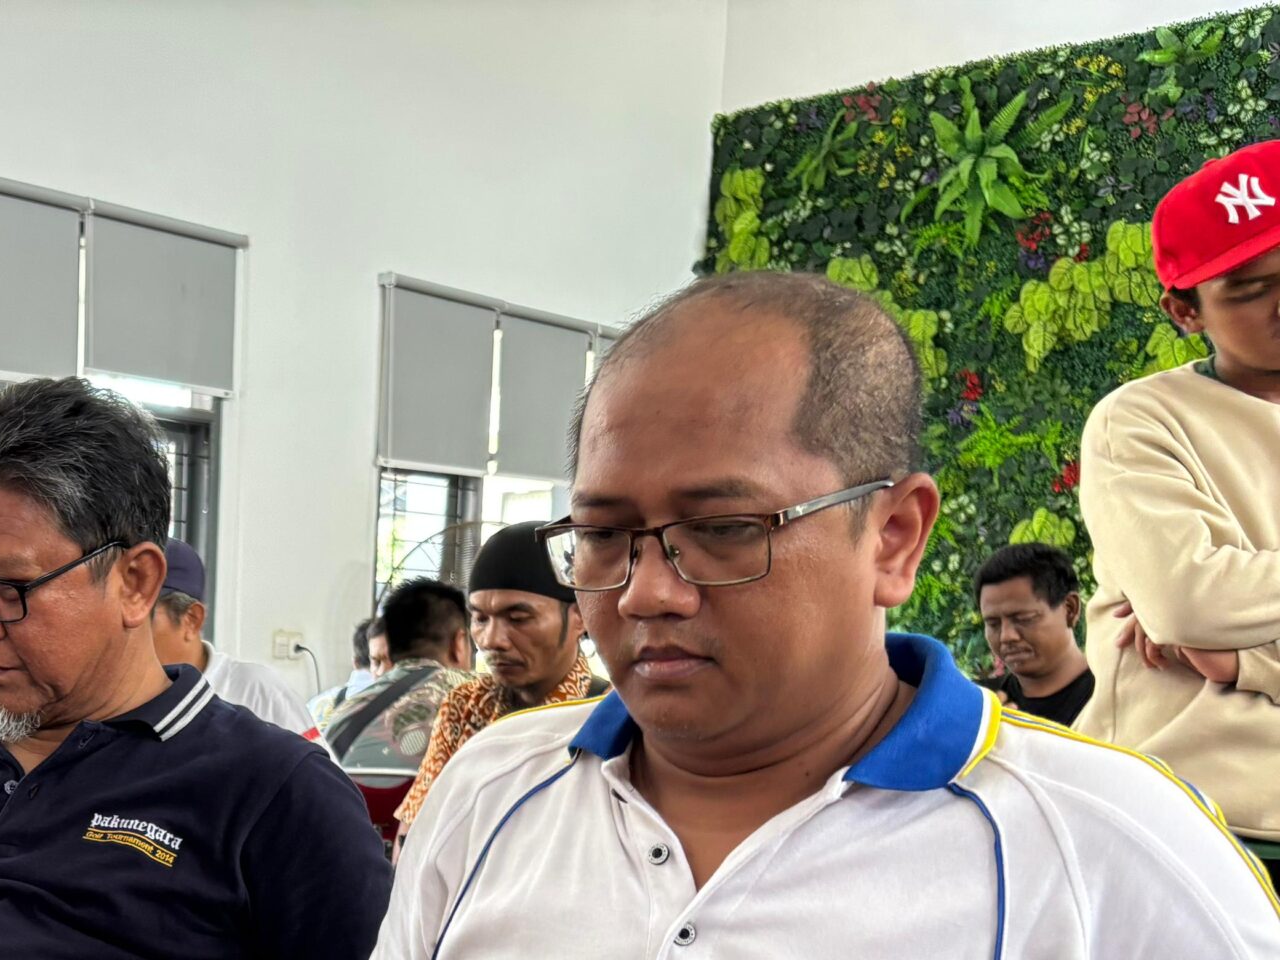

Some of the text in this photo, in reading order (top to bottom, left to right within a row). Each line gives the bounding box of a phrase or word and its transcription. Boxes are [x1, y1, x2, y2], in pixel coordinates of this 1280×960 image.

[1214, 173, 1276, 224] NY
[107, 833, 154, 854] Tournament
[155, 849, 174, 864] 2014
